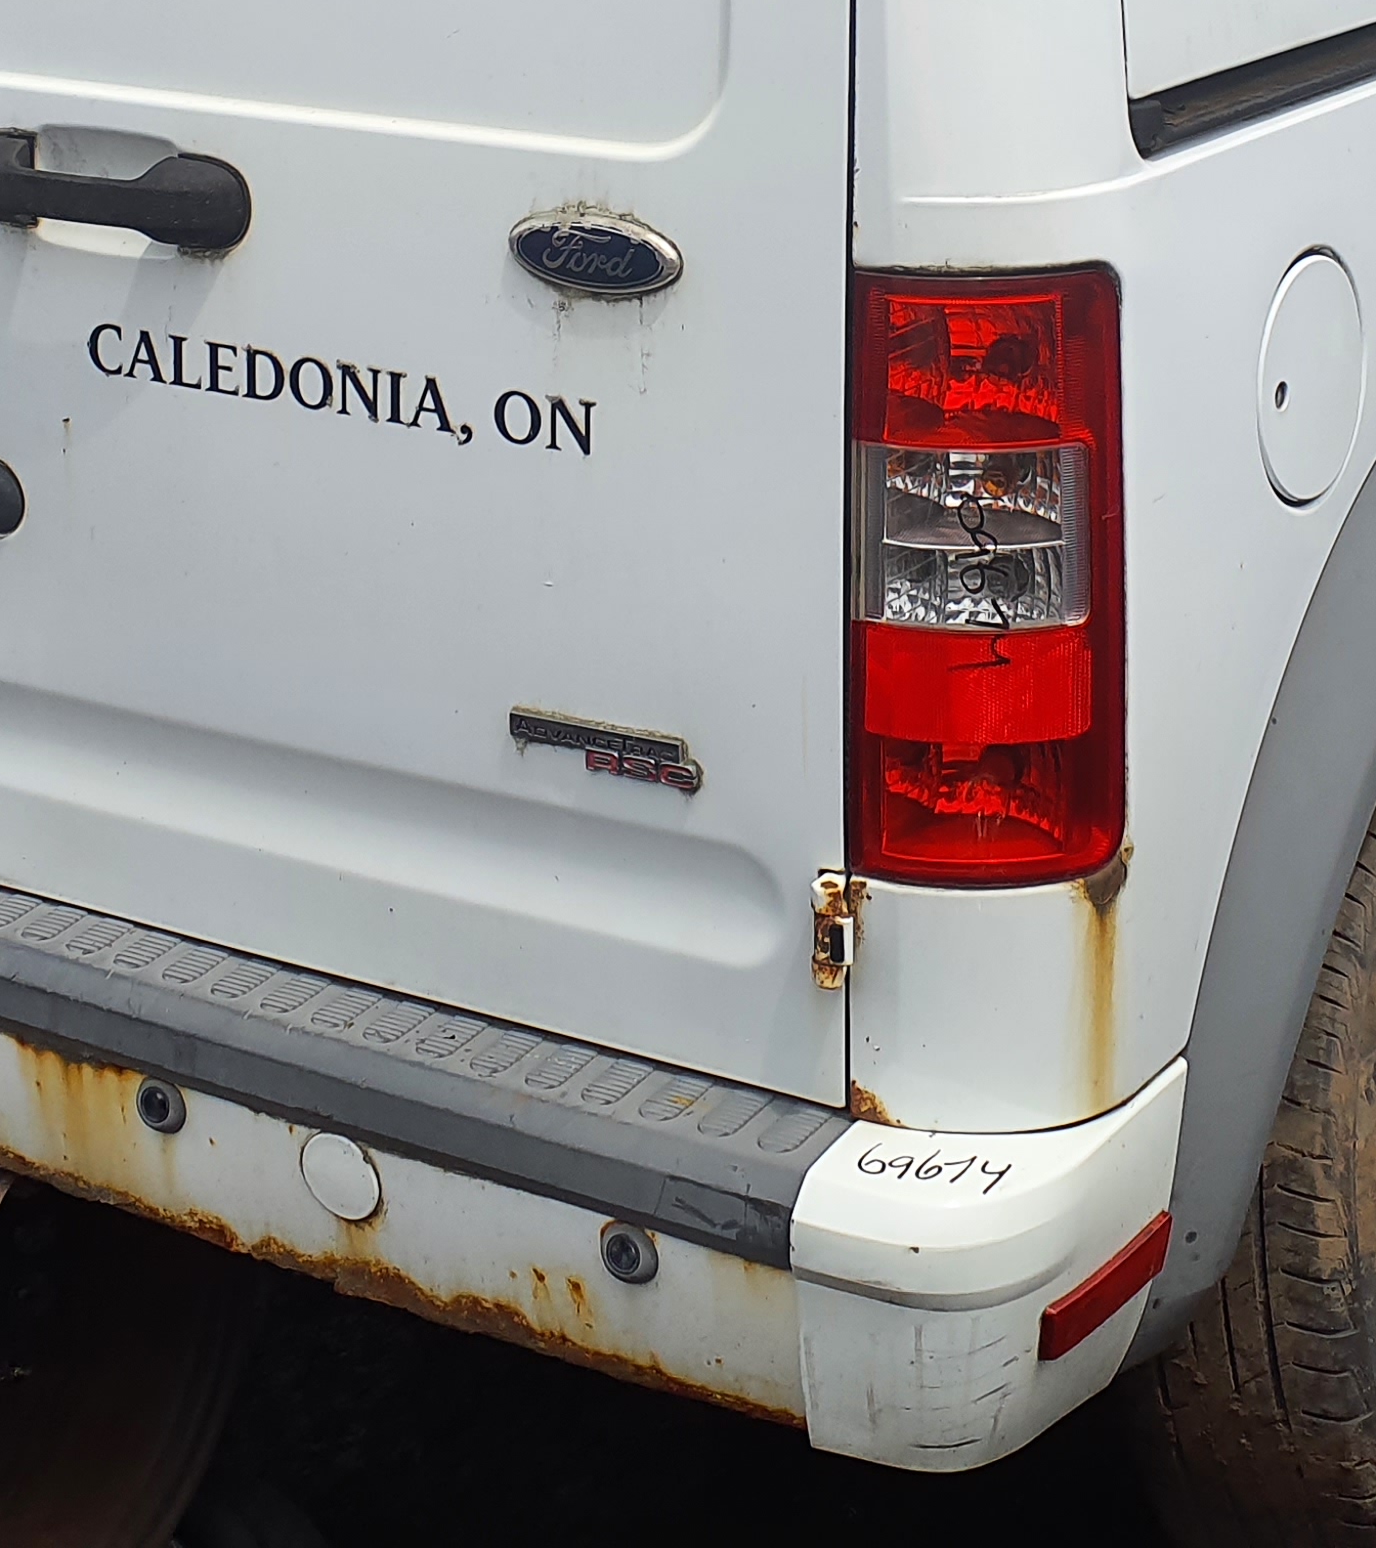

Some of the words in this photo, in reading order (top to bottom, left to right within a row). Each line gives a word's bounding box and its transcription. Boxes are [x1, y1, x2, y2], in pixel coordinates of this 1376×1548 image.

[543, 226, 634, 279] Ford
[87, 323, 474, 446] CALEDONIA,
[493, 389, 597, 457] ON
[585, 746, 700, 791] RSC
[857, 1142, 1012, 1195] 69674
